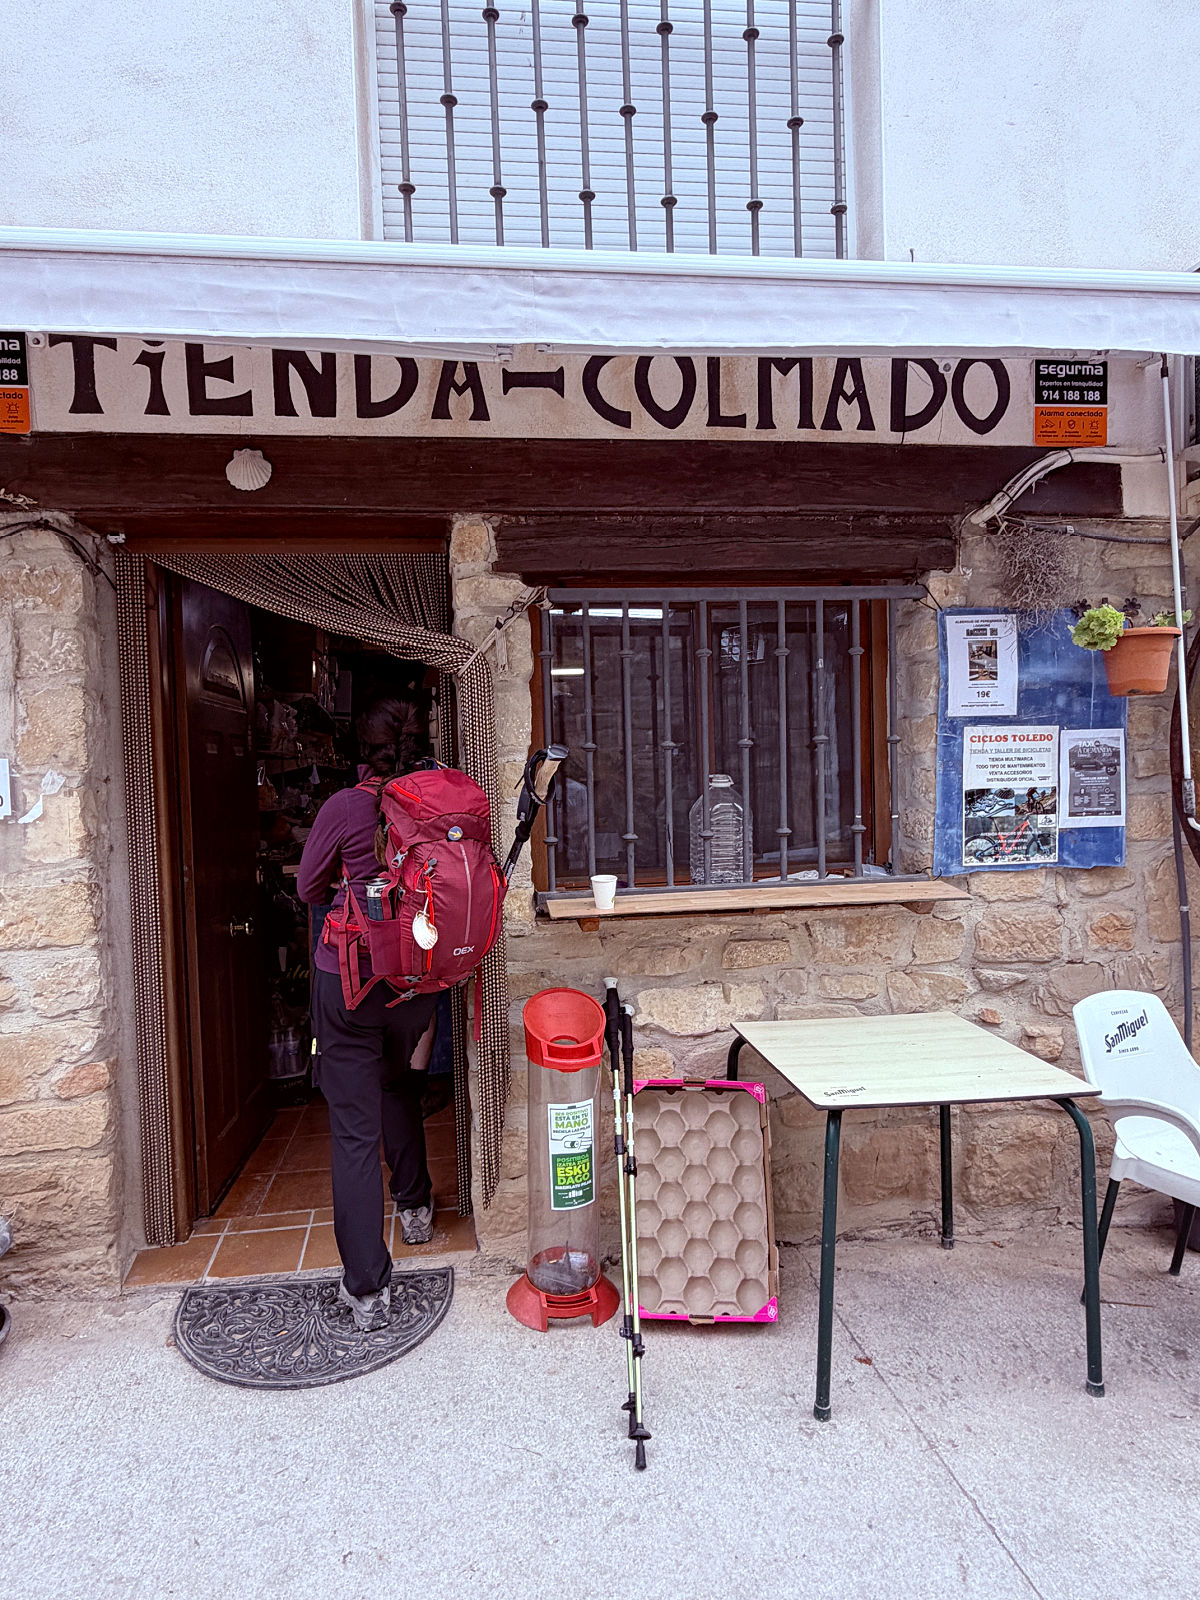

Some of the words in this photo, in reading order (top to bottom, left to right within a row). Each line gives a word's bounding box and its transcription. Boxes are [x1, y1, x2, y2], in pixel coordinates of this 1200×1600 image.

[1040, 364, 1104, 378] segurma
[1042, 390, 1060, 400] 914
[1063, 391, 1080, 401] 188
[1083, 391, 1101, 401] 188
[976, 690, 991, 698] 19€
[969, 734, 1008, 743] CICLOS
[1011, 733, 1053, 742] TOLEDO
[453, 945, 475, 957] OEX
[555, 1117, 589, 1129] MANO
[556, 1162, 590, 1177] ESKU
[557, 1172, 590, 1186] DAGO
